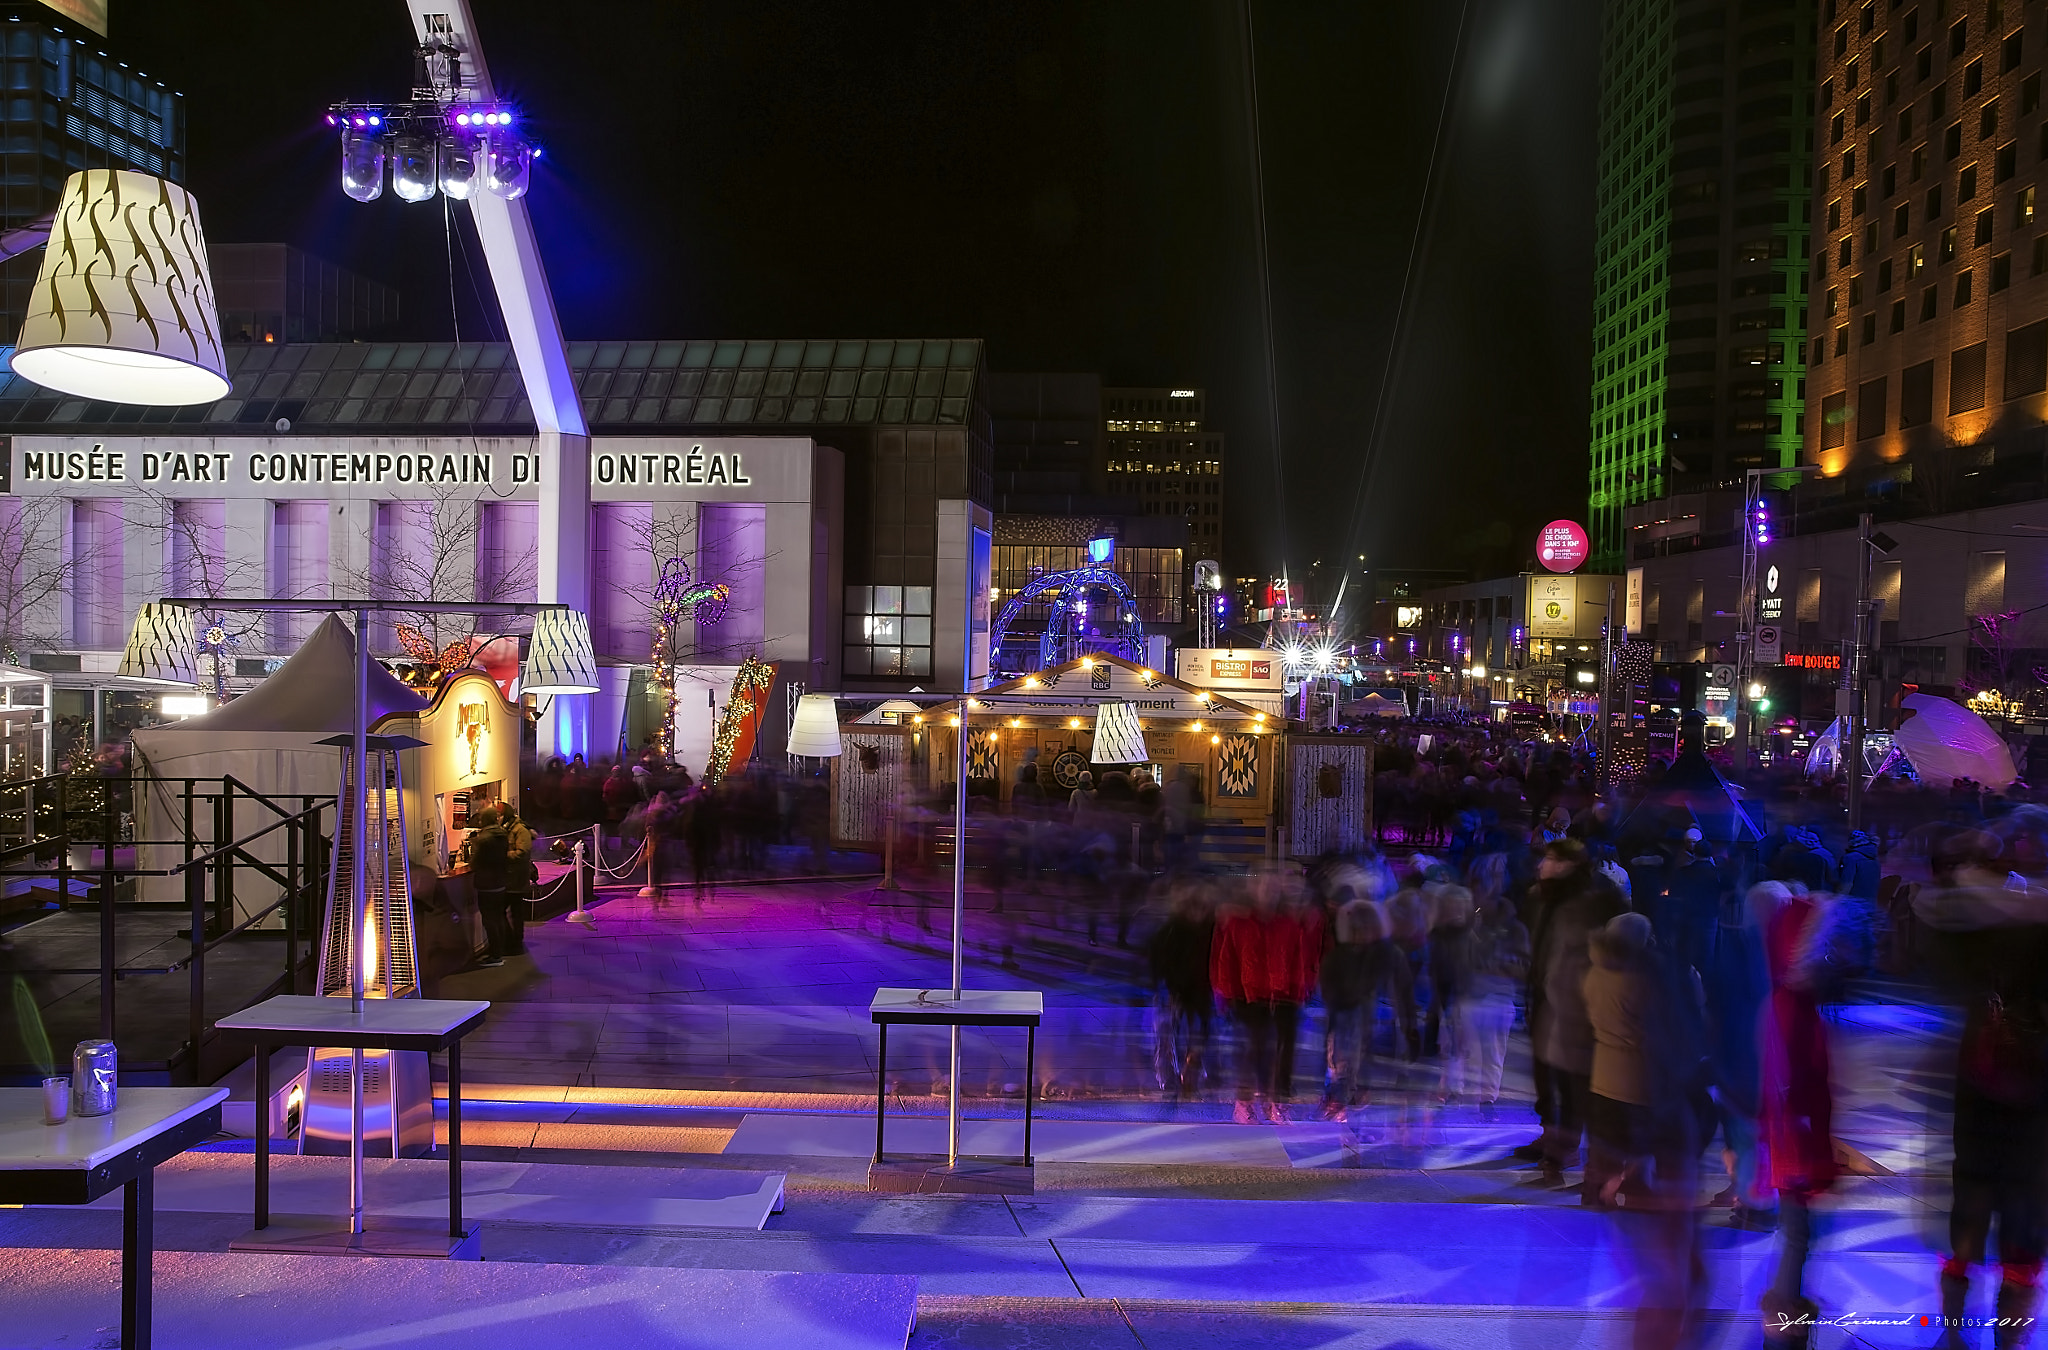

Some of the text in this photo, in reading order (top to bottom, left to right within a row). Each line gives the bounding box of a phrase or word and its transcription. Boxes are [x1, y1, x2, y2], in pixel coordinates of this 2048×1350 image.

[24, 444, 749, 485] MUSÉE D'ART CONTEMPORAIN D ONTRÉAL
[1273, 578, 1289, 591] 22
[1216, 662, 1246, 671] BISTRO
[1804, 655, 1841, 669] ROUGE
